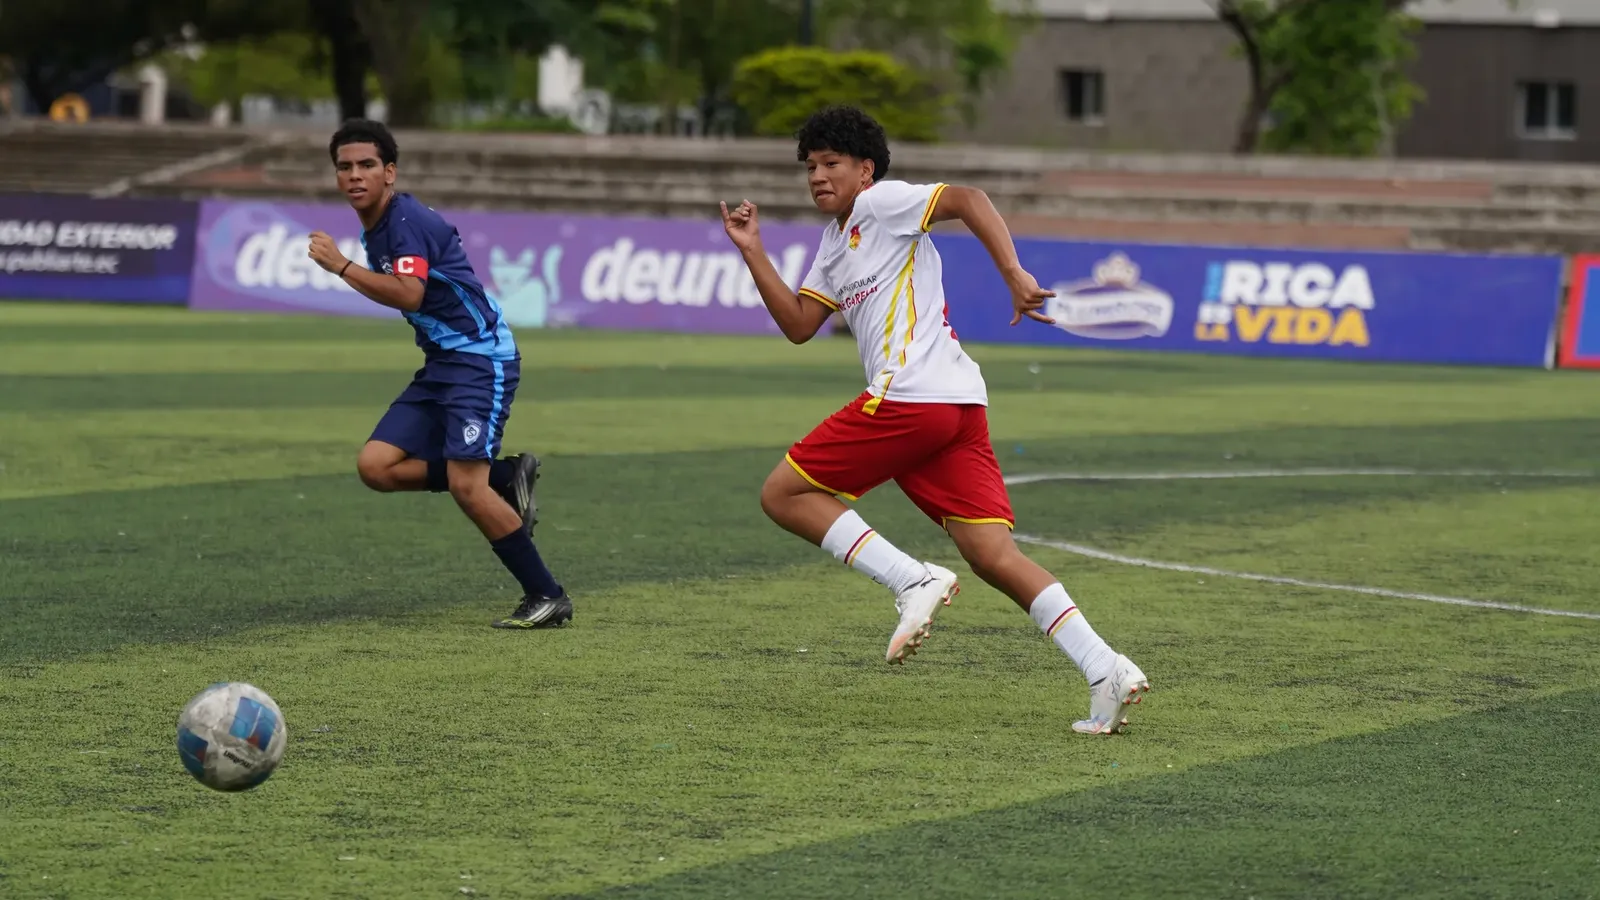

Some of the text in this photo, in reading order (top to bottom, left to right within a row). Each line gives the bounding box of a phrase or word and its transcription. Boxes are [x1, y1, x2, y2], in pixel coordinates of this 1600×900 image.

[0, 219, 176, 249] DAD EXTERIOR
[398, 257, 414, 274] C
[1222, 260, 1375, 309] RICA
[1232, 304, 1370, 347] VIDA
